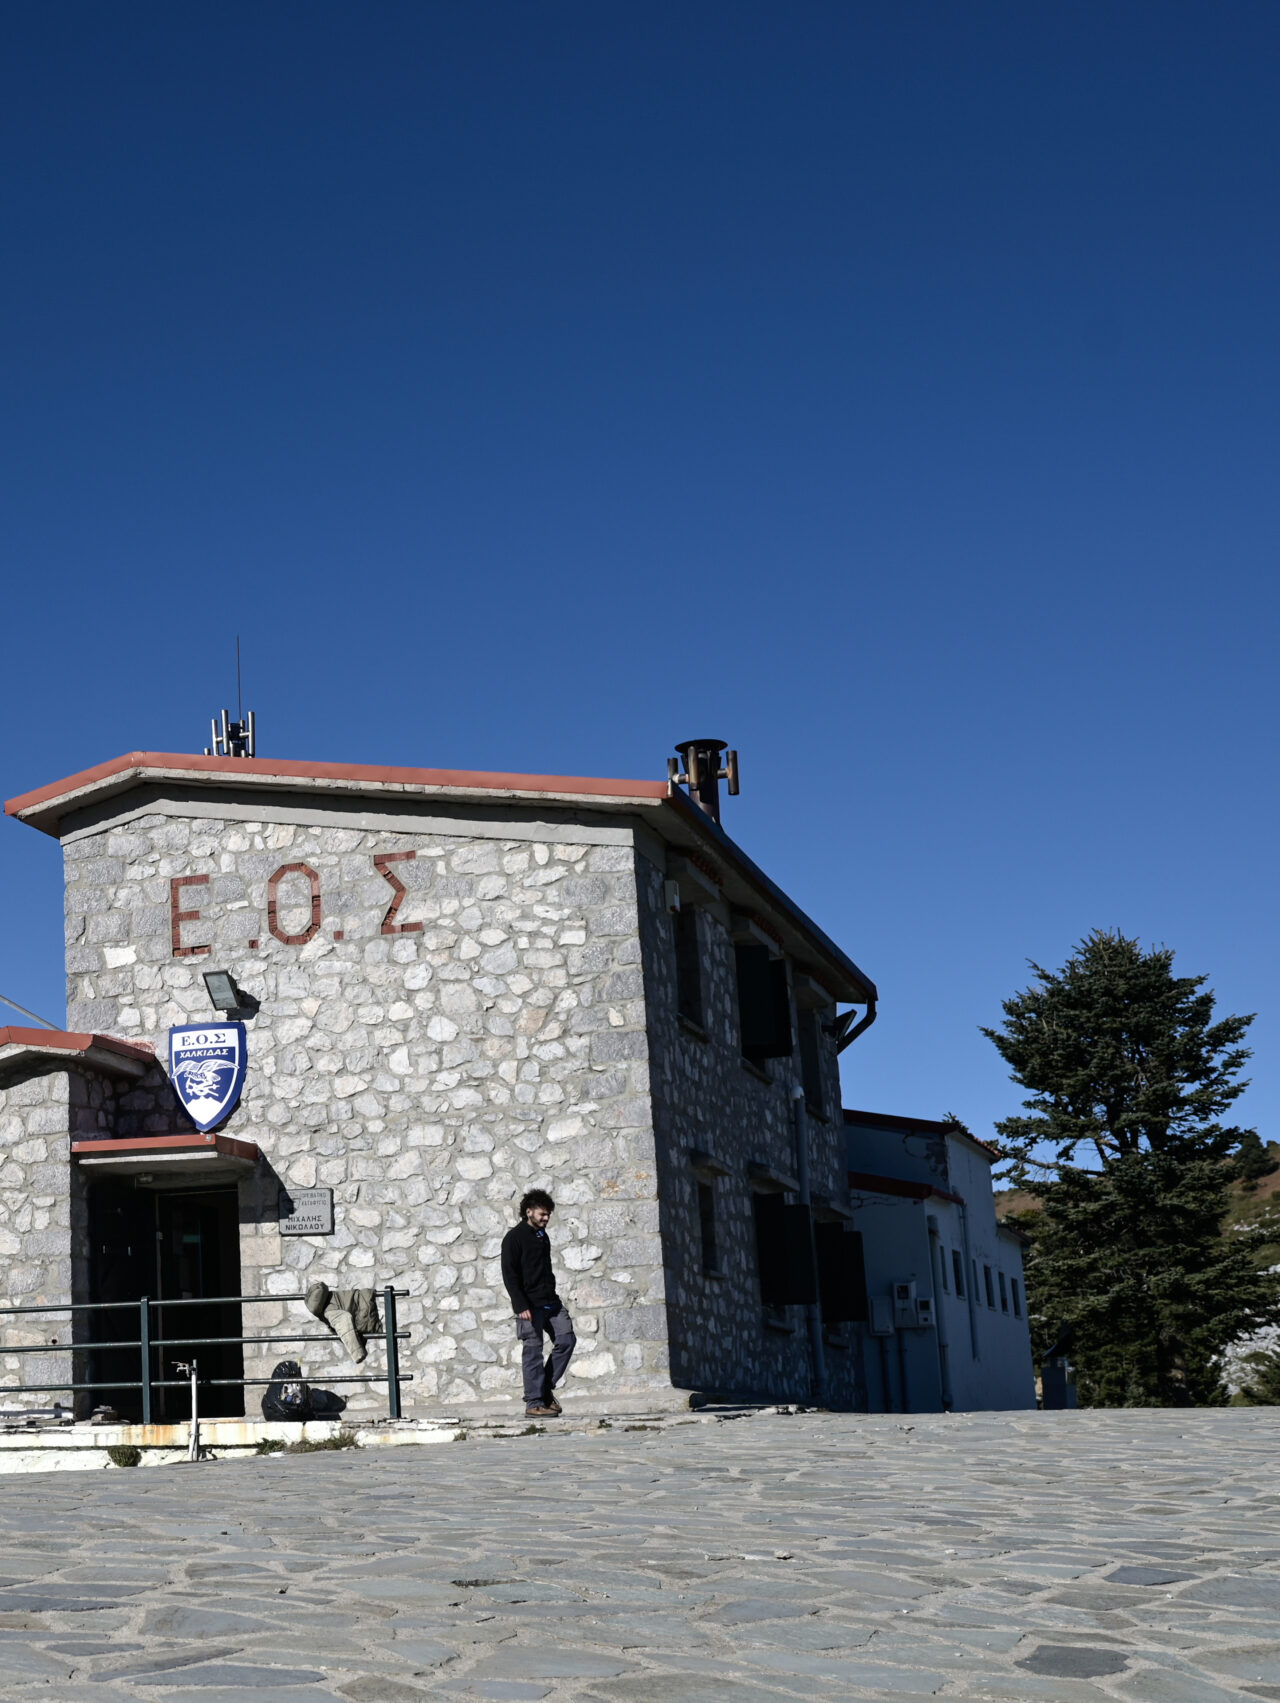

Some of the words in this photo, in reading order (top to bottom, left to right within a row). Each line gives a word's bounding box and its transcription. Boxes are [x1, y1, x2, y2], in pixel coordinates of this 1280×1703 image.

[181, 1032, 226, 1047] Ε.Ο.Σ
[179, 1048, 229, 1059] ΧΑΛΚΙΔΑΣ
[287, 1215, 323, 1223] ΜΙΧΑΛΗΣ
[285, 1223, 325, 1231] ΝΙΚΟΛΑΟΥ
